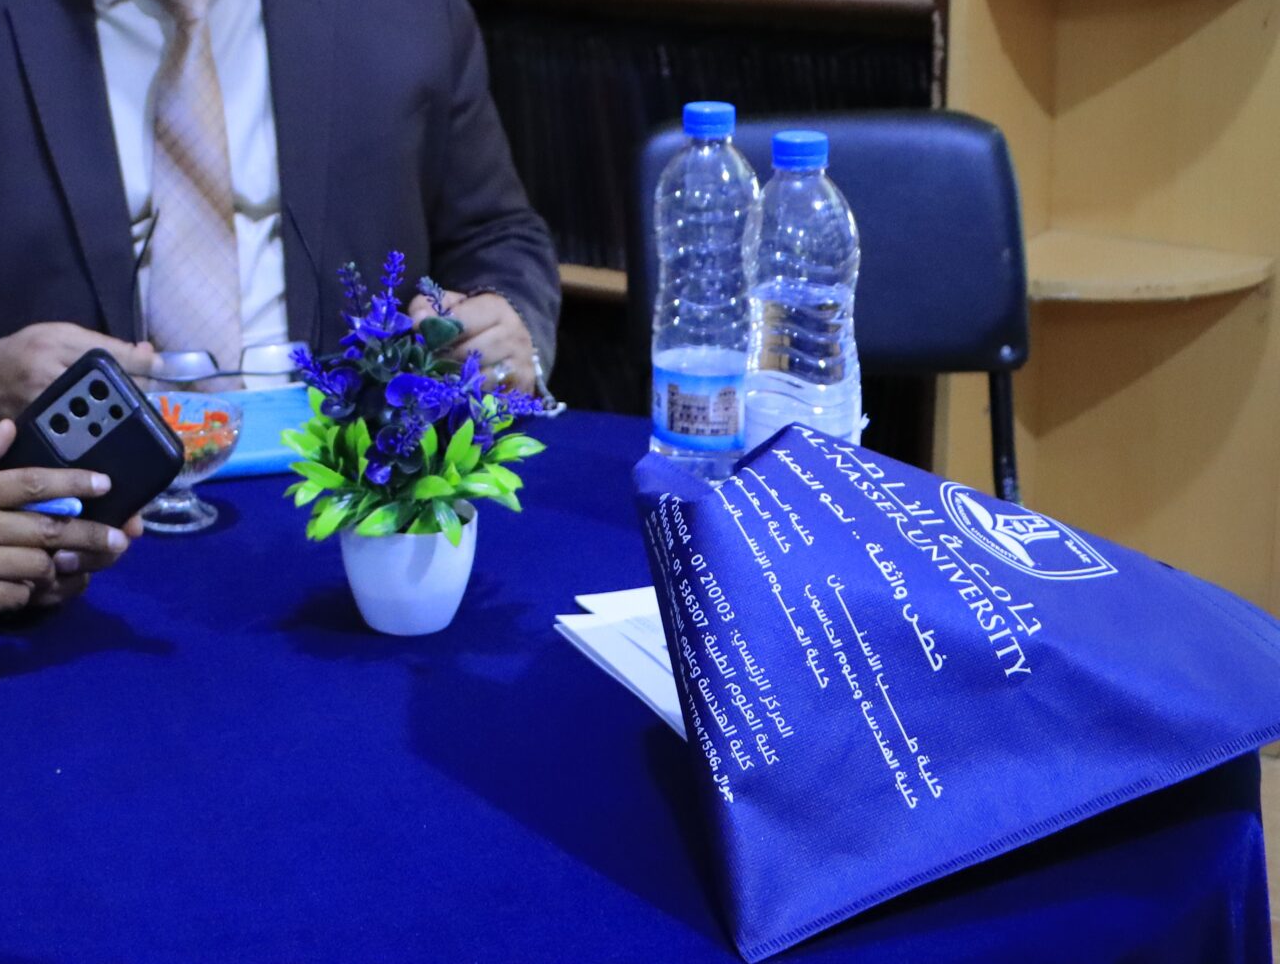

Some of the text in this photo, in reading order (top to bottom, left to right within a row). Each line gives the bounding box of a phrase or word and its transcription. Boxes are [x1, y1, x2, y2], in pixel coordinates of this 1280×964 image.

[772, 447, 824, 490] التميز
[789, 512, 815, 547] كلية
[819, 492, 856, 524] نحو
[767, 519, 790, 554] كلية
[792, 425, 1032, 679] AL-NASSER UNIVERSITY
[834, 443, 1042, 636] جامعة الناصر
[673, 558, 682, 576] 01
[690, 554, 707, 572] 01
[866, 542, 908, 600] واثقة
[678, 579, 710, 629] 536307
[700, 569, 736, 623] 210103
[764, 571, 812, 647] العلوم
[680, 636, 702, 679] وعلوم
[702, 632, 737, 680] الطبية:
[730, 629, 771, 692] الرئيسي:
[903, 603, 947, 672] خطى
[806, 647, 829, 689] كلية
[827, 574, 943, 799] كلية طب الأسنان
[697, 677, 738, 738] الهندسة
[725, 682, 763, 732] العلوم
[759, 694, 794, 738] المركز
[804, 584, 919, 809] كلية الهندسة وعلوم الحاسوب
[688, 695, 722, 767] 777947536
[729, 737, 755, 771] كلية
[756, 732, 780, 766] كلية
